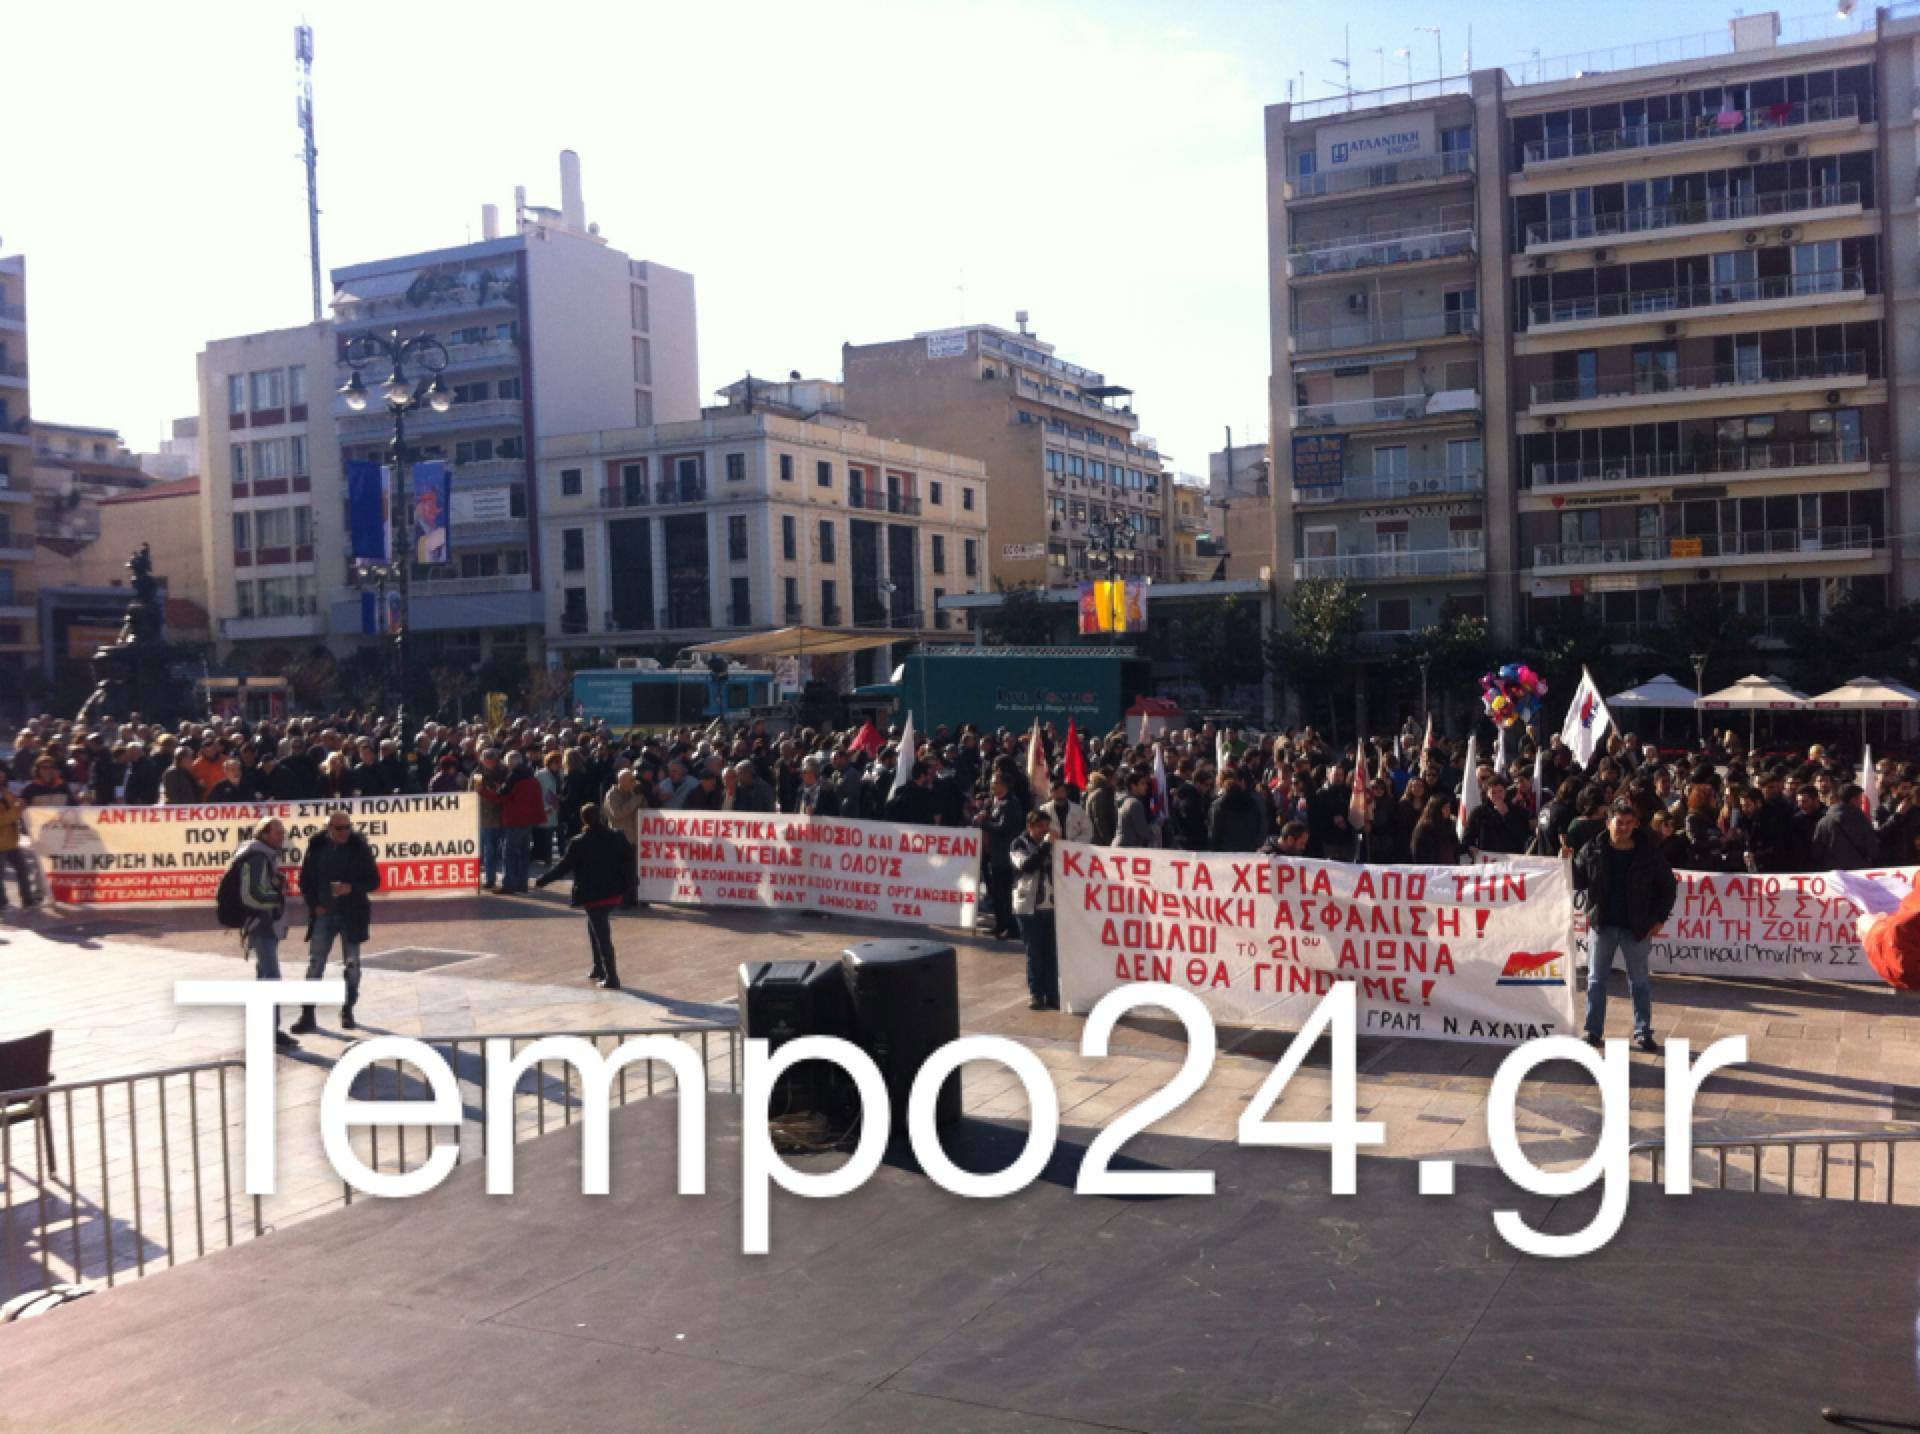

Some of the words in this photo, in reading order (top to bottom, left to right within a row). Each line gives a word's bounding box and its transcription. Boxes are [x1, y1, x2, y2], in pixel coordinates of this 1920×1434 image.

[97, 804, 291, 824] ΑΝΤΙΣΤΕΚΟΜΑΣΤΕ
[298, 801, 353, 817] ΣΤΗΝ
[361, 795, 460, 814] ΠΟΛΙΤΙΚΗ
[186, 827, 229, 844] ΠΟΥ
[641, 815, 777, 840] ΑΠΟΚΛΕΙΣΤΙΚΑ
[784, 822, 863, 847] ΔΗΜΟΣΙΟ
[868, 833, 893, 850] ΚΑΙ
[899, 832, 978, 857] ΔΩΡΕΑΝ
[49, 853, 84, 870] ΤΗΝ
[92, 852, 146, 869] ΚΡΙΣΗ
[152, 851, 177, 867] ΝΑ
[385, 839, 476, 858] ΚΕΦΑΛΑΙΟ
[640, 840, 725, 862] ΣΥΣΤΗΜΑ
[735, 845, 803, 866] ΥΓΕΙΑΣ
[809, 853, 833, 870] ΓΙΑ
[840, 852, 903, 877] ΟΛΟΥΣ
[640, 865, 763, 883] ΣΥΝΕΡΓΑΖΟΜΕΝΕΣ
[1062, 849, 1152, 884] ΚΑΤΩ
[1170, 860, 1215, 891] ΤΑ
[1231, 862, 1333, 897] ΧΕΡΙΑ
[1353, 870, 1427, 901] ΑΠΟ
[1451, 873, 1527, 902] ΤΗΝ
[1725, 875, 1780, 897] ΑΠΟ
[1790, 876, 1826, 896] ΤΟ
[678, 885, 703, 897] ΙΚΑ
[773, 890, 807, 904] ΝΑΤ
[818, 893, 878, 912] ΔΗΜΟΣΙΟ
[1084, 883, 1255, 929] ΚΟΙΝΩΝΙΚΗ
[1685, 896, 1723, 917] ΓΙΑ
[1740, 896, 1783, 919] ΤΙΣ
[1101, 917, 1217, 954] ΔΟΥΛΟΙ
[1338, 938, 1456, 975] ΑΙΩΝΑ
[1677, 919, 1711, 940] ΚΑΙ
[1719, 919, 1751, 941] ΤΗ
[1762, 921, 1809, 942] ΖΩΗ
[1815, 921, 1862, 944] ΜΑΣ
[1115, 952, 1172, 984] ΔΕΝ
[1186, 957, 1231, 988] ΘΑ
